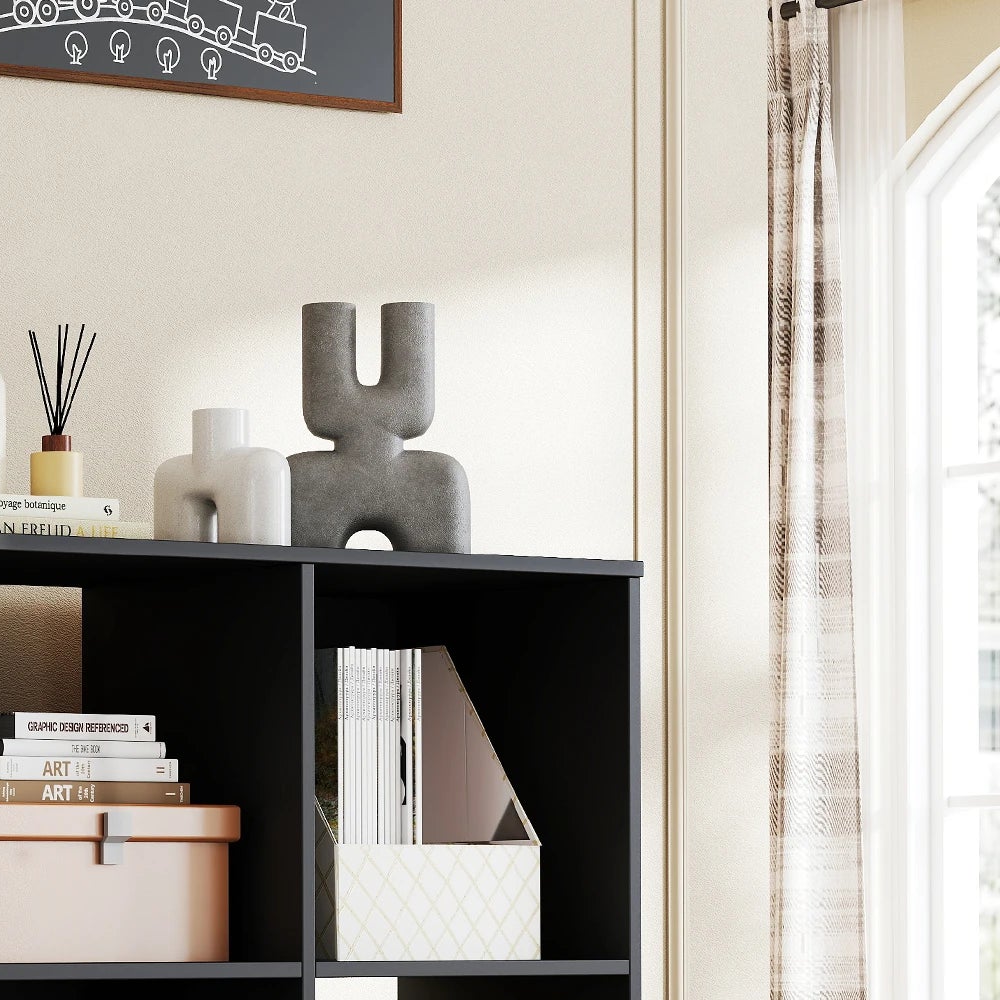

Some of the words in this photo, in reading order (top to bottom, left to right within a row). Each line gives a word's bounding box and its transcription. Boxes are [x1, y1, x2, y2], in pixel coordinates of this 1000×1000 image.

[24, 499, 66, 513] botanique
[22, 523, 72, 537] FREUD
[76, 526, 85, 537] A
[91, 526, 118, 538] LIFE
[27, 721, 58, 732] GRAPHIC
[59, 722, 84, 733] DESIGN
[85, 723, 129, 733] REFERENCED
[71, 744, 80, 753] THE
[42, 760, 71, 776] ART
[41, 783, 73, 801] ART
